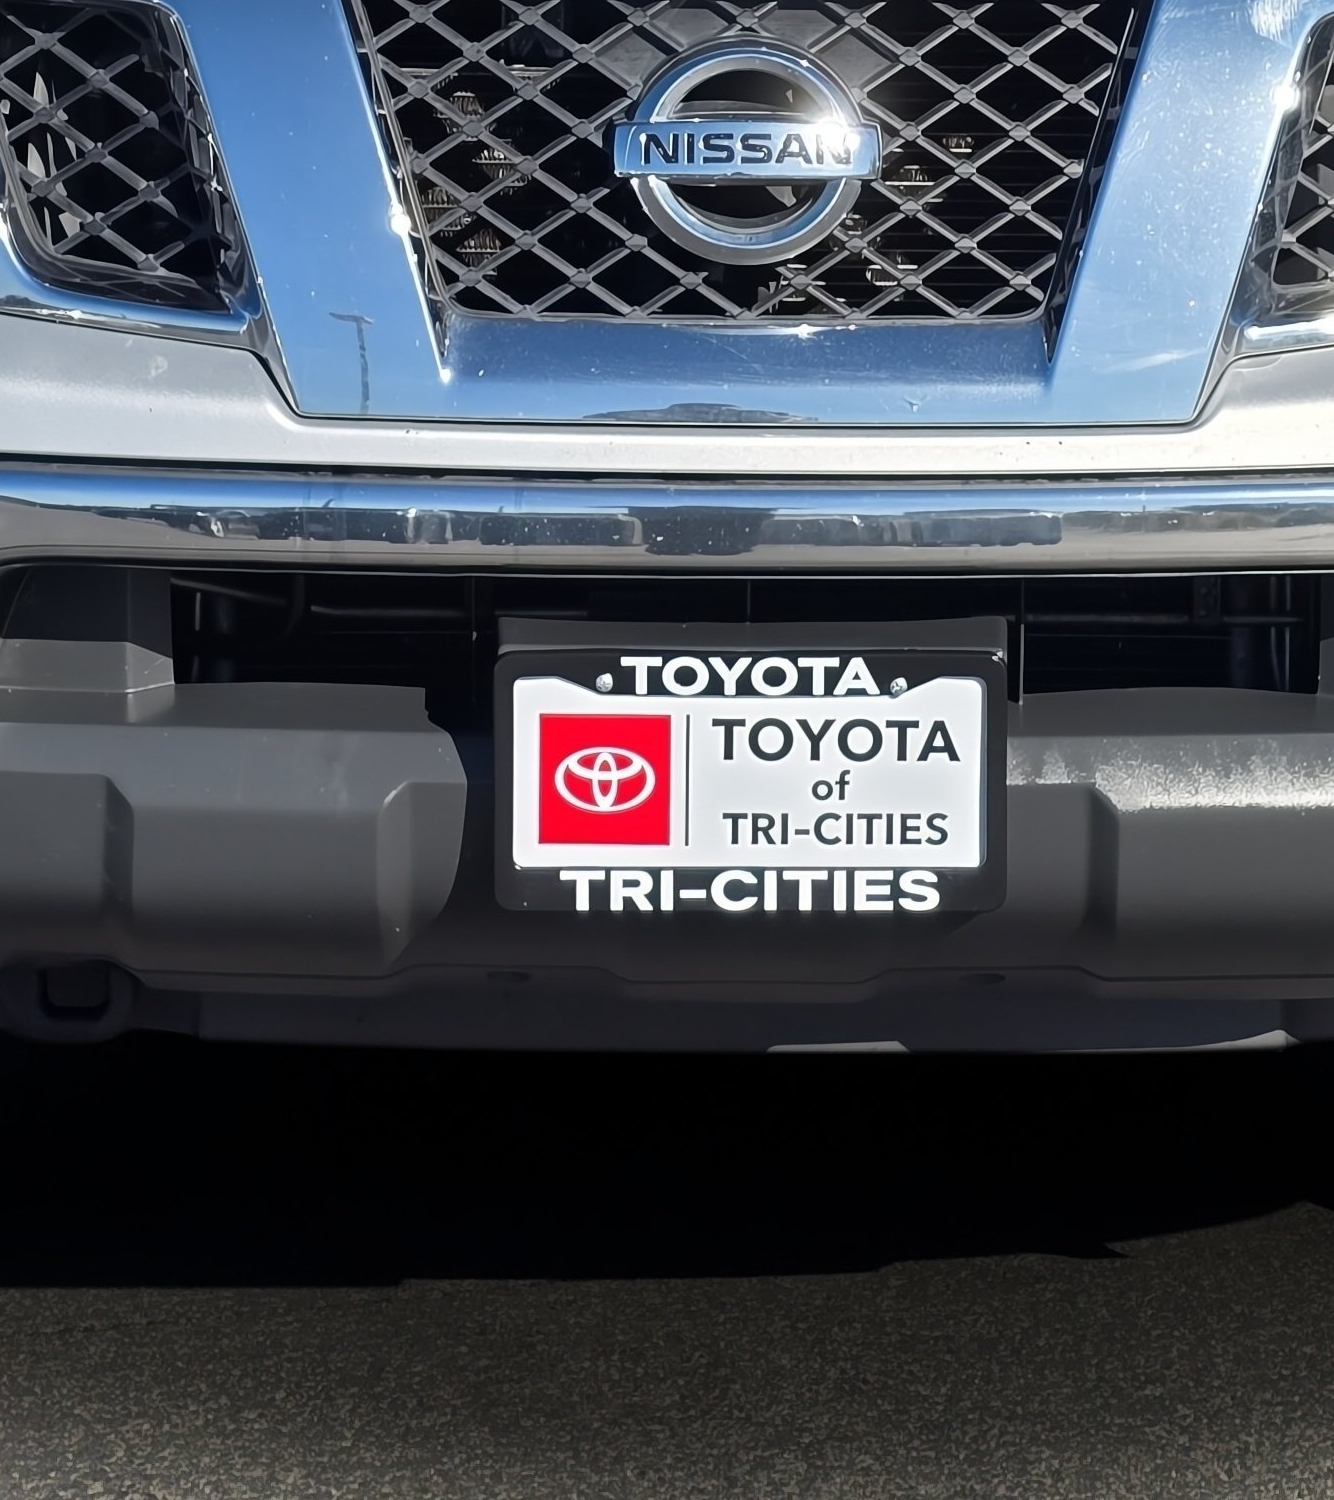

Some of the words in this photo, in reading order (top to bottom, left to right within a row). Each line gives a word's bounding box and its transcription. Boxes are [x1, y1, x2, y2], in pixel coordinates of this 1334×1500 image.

[639, 132, 854, 165] NISSAN
[620, 656, 880, 695] TOYOTA
[712, 718, 961, 762] TOYOTA
[811, 770, 851, 801] of
[722, 812, 948, 846] TRI-CITIES
[559, 869, 941, 912] TRI-CITIES
